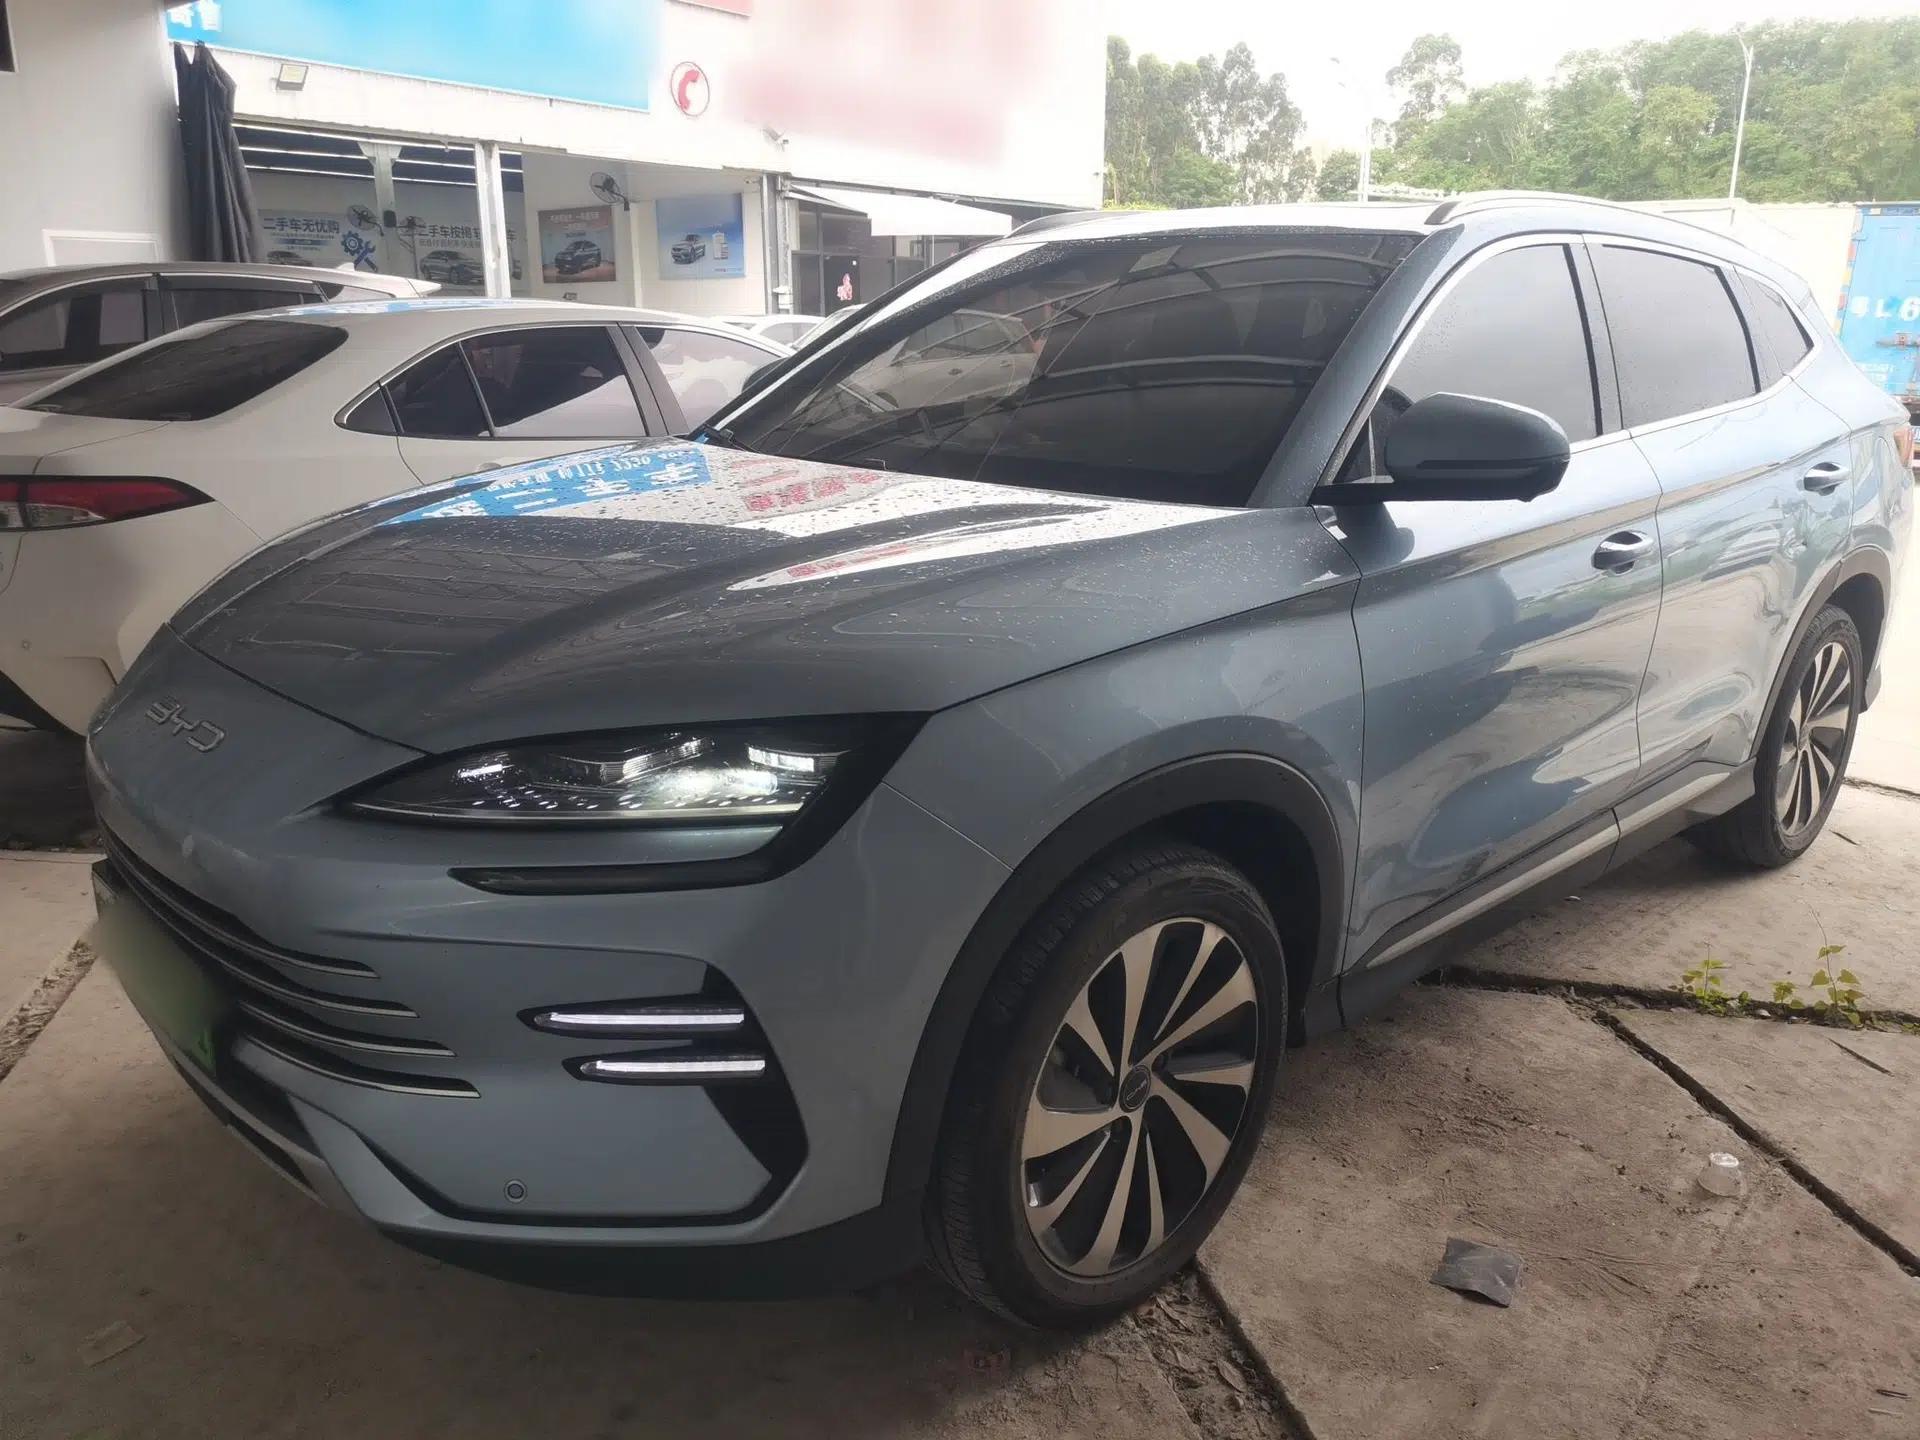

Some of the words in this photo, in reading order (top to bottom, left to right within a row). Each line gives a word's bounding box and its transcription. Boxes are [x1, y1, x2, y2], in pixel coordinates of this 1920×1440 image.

[263, 217, 340, 234] 二手车无忧购
[145, 696, 226, 752] BYD
